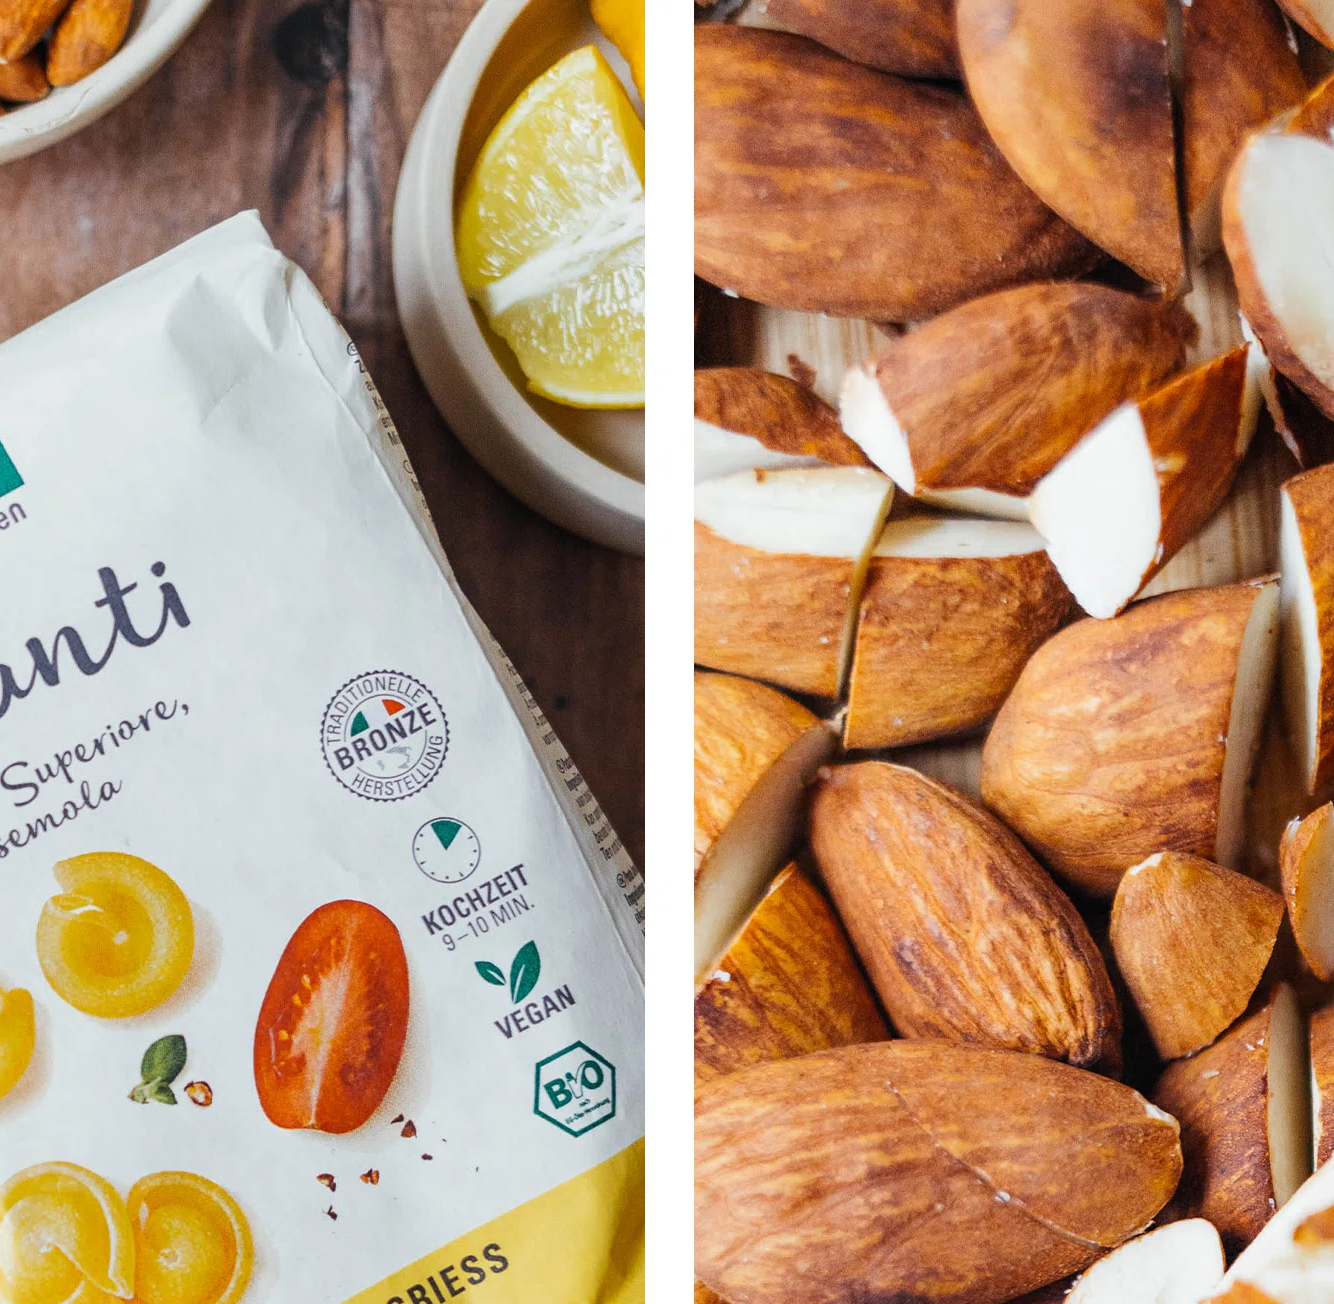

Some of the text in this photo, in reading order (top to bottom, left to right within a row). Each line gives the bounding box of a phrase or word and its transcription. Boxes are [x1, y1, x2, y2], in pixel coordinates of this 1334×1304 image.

[326, 676, 425, 747] TRADITIONELLE
[333, 702, 437, 771] BRONZE
[0, 698, 190, 807] Superiore,
[351, 735, 444, 796] HERSTELLUNG
[421, 864, 529, 936] KOCHZEIT
[492, 893, 535, 929] MIN.
[494, 984, 577, 1039] VEGAN
[543, 1060, 604, 1109] BIO
